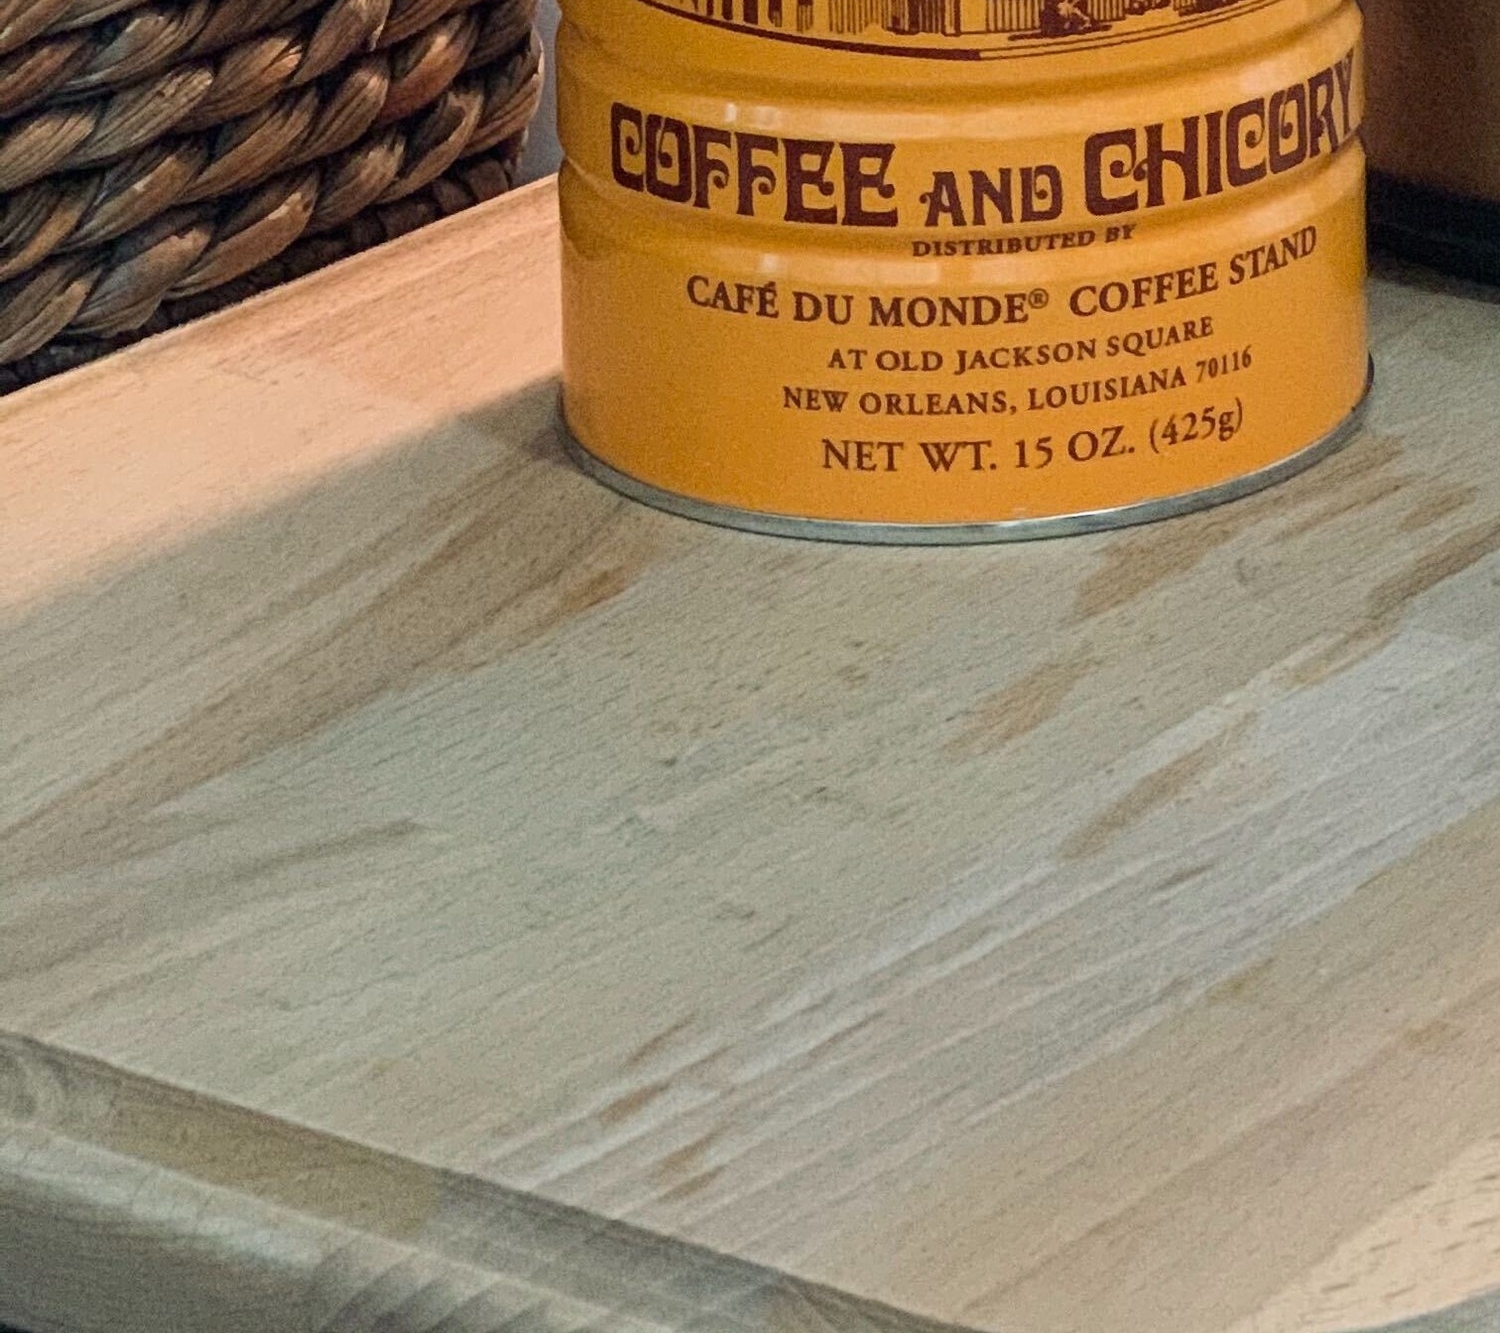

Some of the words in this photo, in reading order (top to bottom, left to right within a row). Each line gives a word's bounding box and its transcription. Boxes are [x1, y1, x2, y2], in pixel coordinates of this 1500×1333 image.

[610, 101, 898, 228] COFFEE
[920, 165, 1065, 228] AND
[1083, 54, 1353, 219] CHICORY
[686, 274, 778, 318] CAFÉ
[793, 292, 854, 325] DU
[1069, 263, 1219, 319] COFFEE
[1228, 225, 1318, 285] STAND
[912, 230, 1096, 258] DISTRIBUTED
[1105, 223, 1137, 244] BY
[783, 386, 849, 413] NEW
[859, 389, 1018, 418] ORLEANS,
[1027, 366, 1187, 413] LOUISIANA
[1196, 345, 1253, 386] 70116
[828, 347, 868, 372] AT
[875, 347, 944, 373] OLD
[954, 338, 1096, 376] JACKSON
[1105, 315, 1214, 360] SQUARE
[821, 439, 906, 474] NET
[918, 439, 997, 472] WT.
[1015, 437, 1055, 470] 15
[1067, 425, 1136, 464] OZ.
[1149, 397, 1243, 456] (425g)
